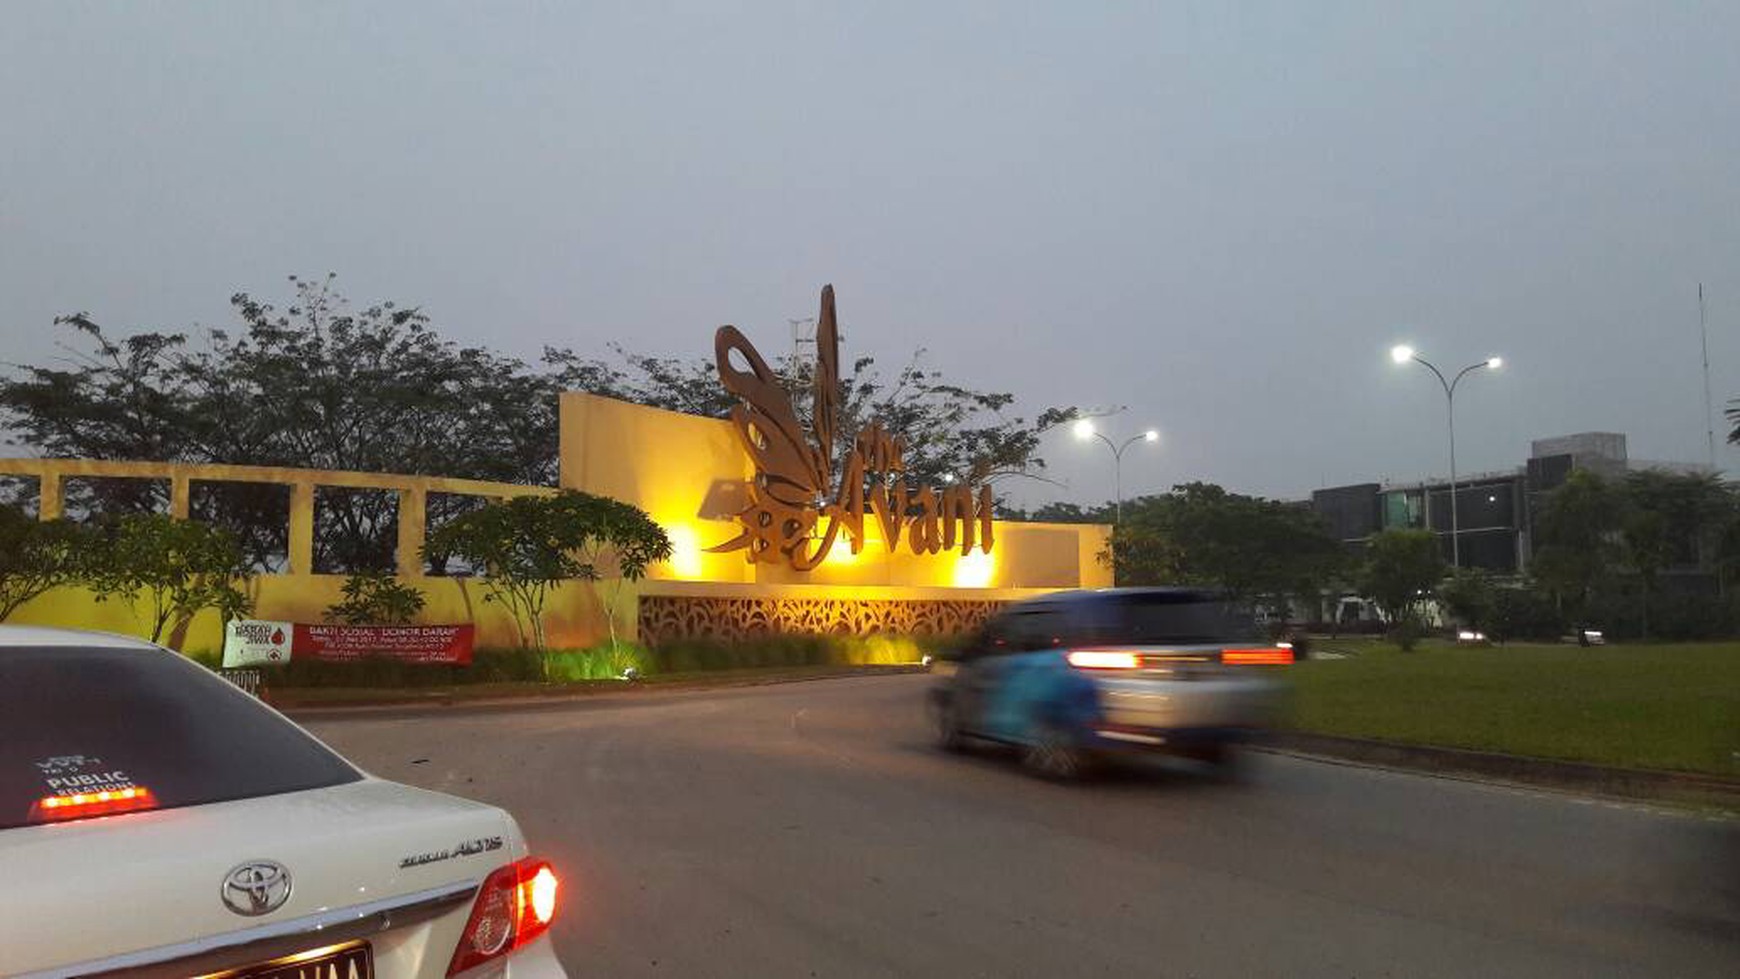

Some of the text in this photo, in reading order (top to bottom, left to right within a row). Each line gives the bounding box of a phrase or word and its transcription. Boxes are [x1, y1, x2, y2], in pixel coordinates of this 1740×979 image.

[780, 448, 995, 572] Avani
[309, 626, 338, 636] BAKTI
[47, 770, 129, 789] PUBLIC
